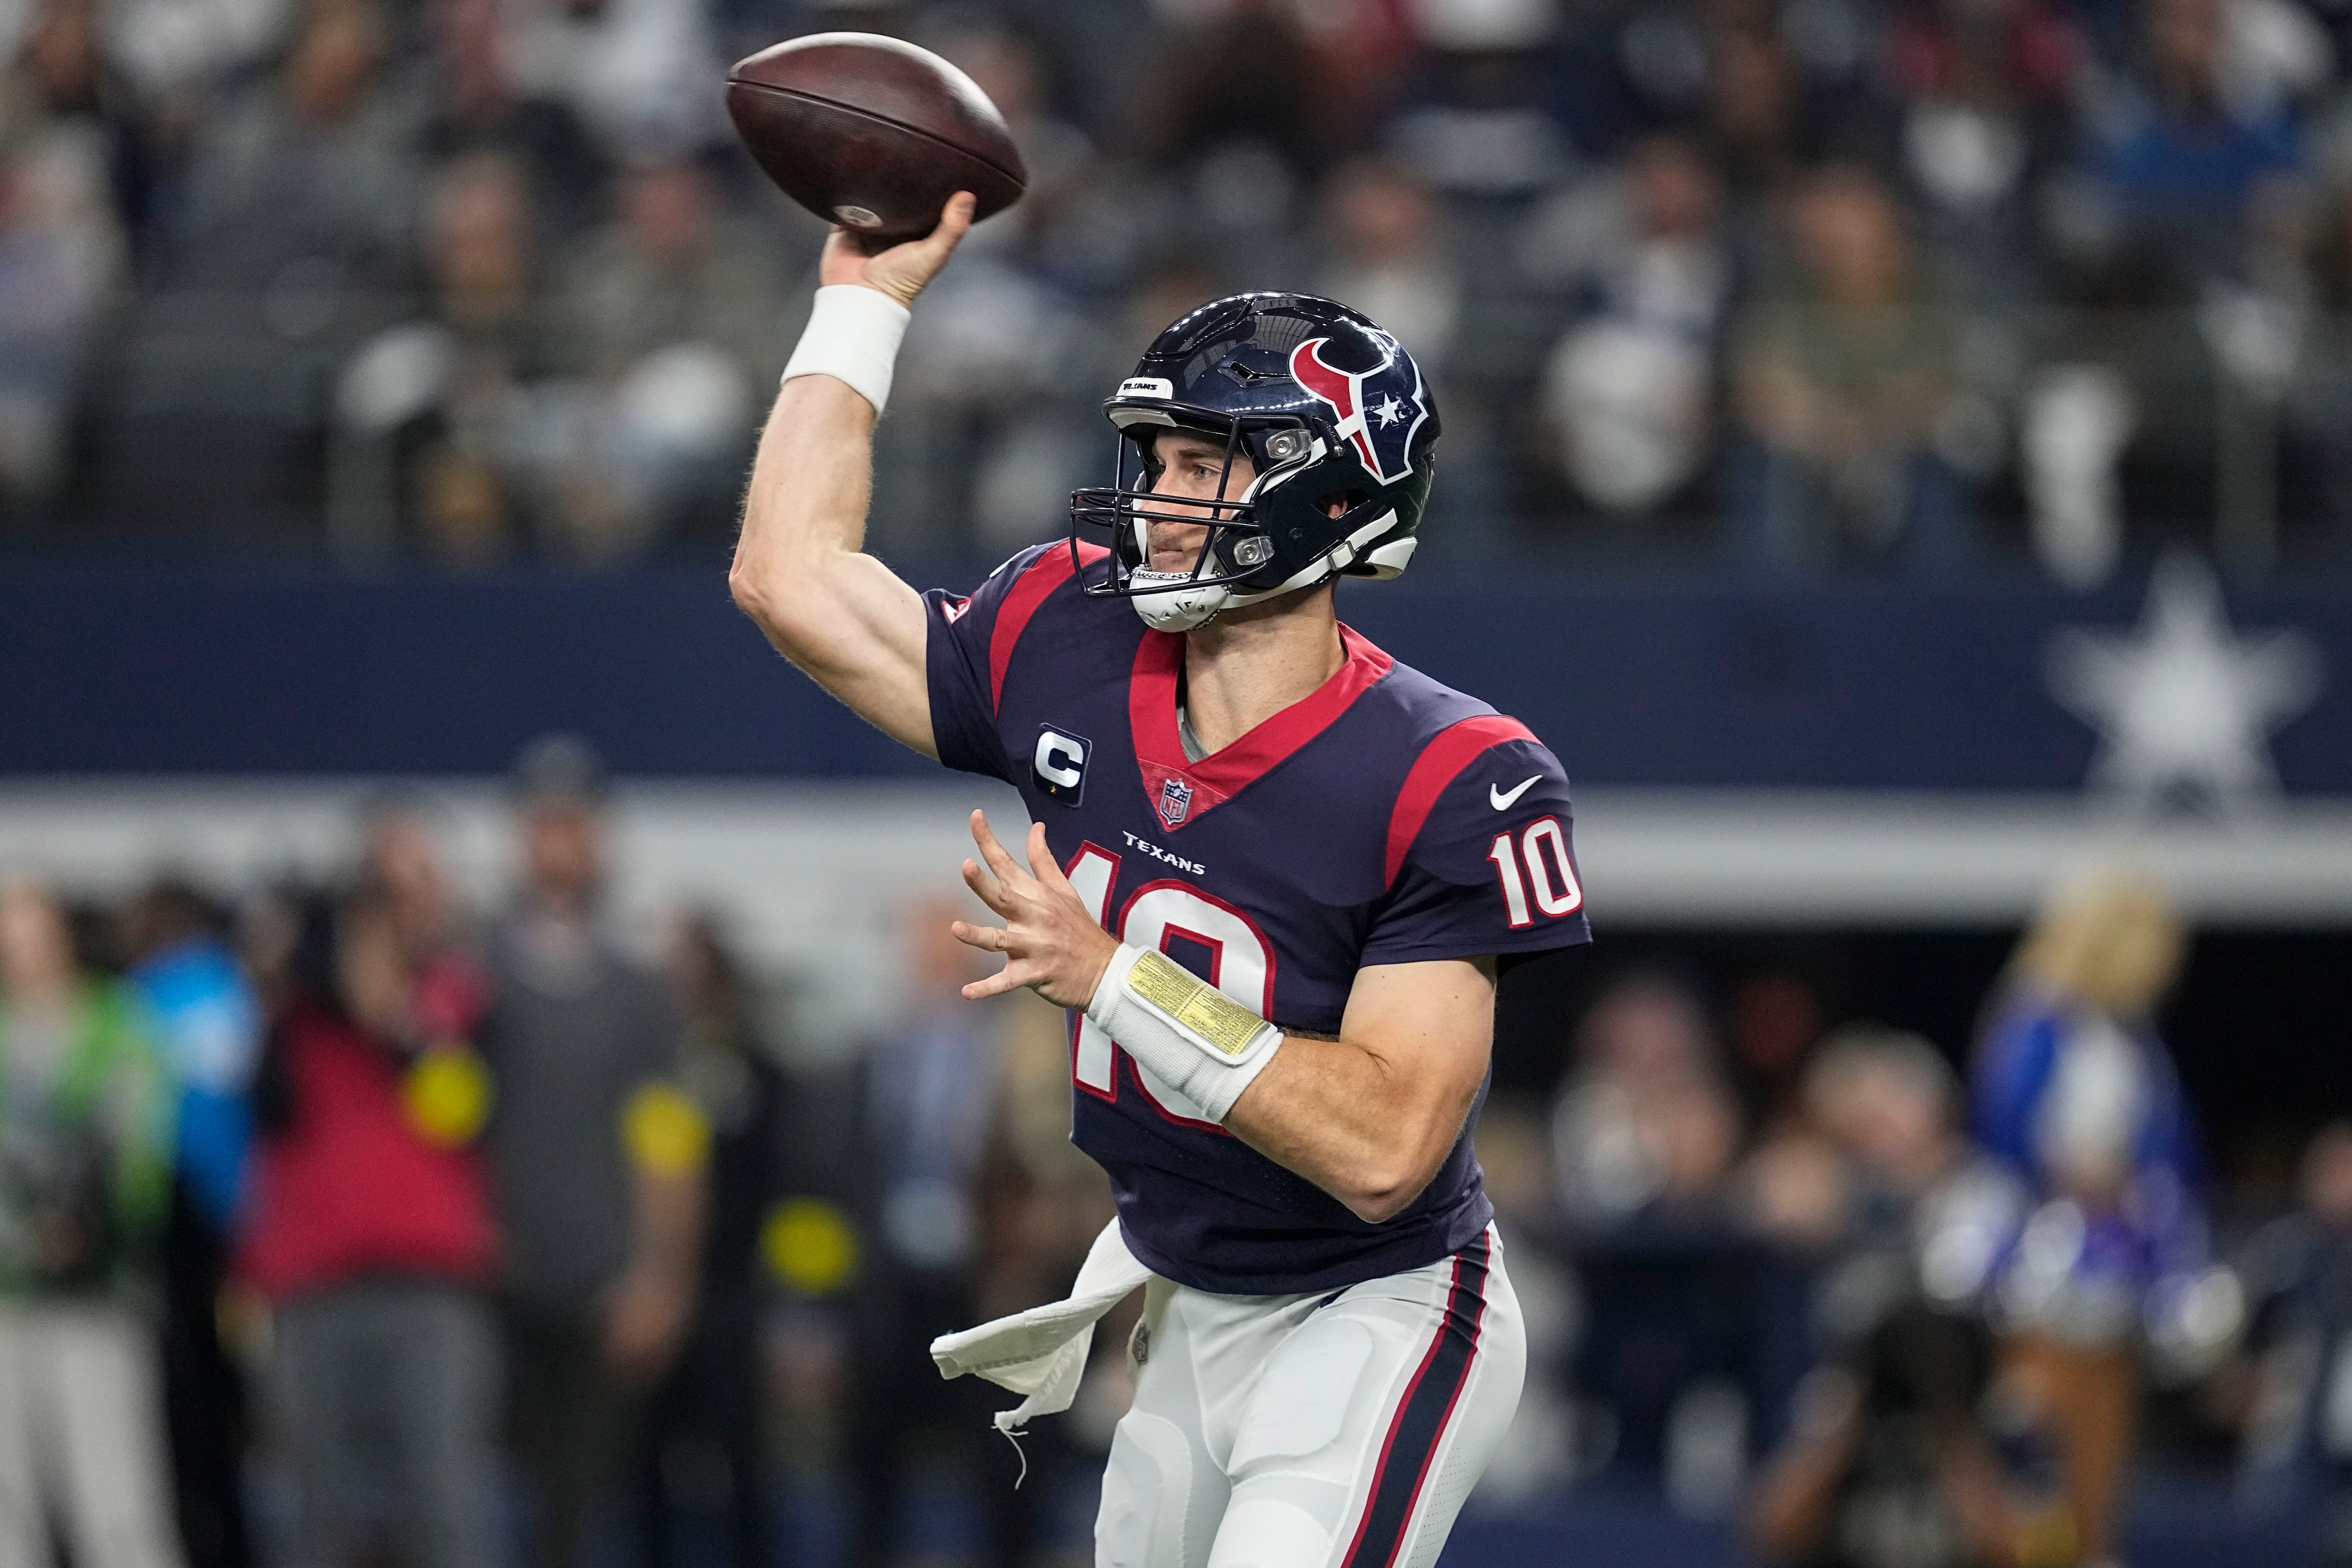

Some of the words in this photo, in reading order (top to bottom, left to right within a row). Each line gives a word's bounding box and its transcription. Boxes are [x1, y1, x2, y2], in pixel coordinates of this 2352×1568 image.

[1035, 731, 1083, 788] C
[1164, 797, 1181, 816] NFL
[1122, 830, 1206, 875] TEXANS
[1486, 815, 1584, 929] 10
